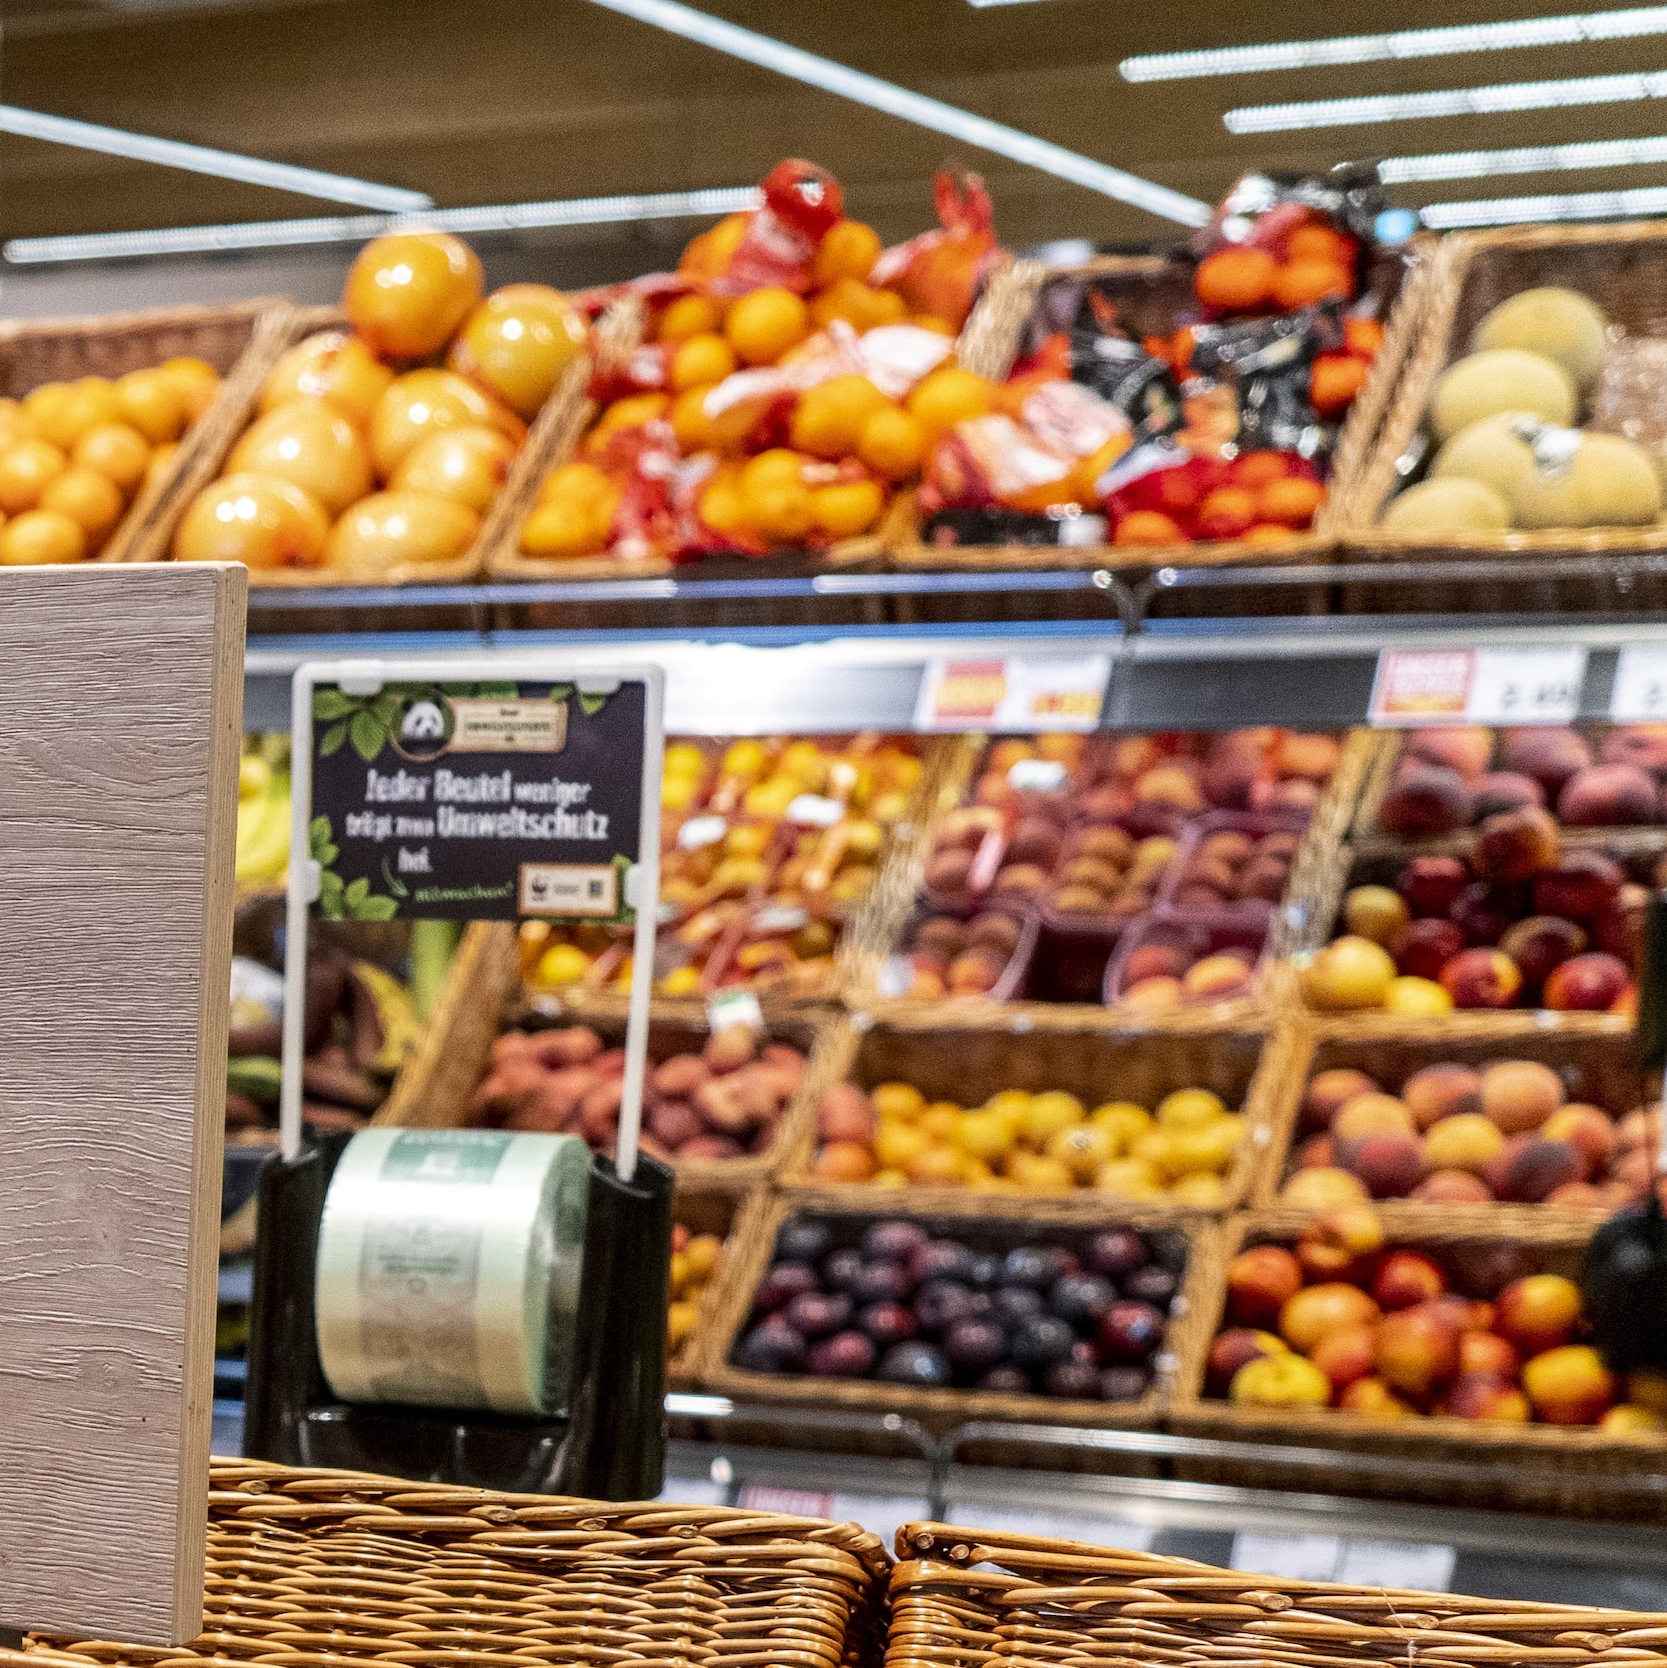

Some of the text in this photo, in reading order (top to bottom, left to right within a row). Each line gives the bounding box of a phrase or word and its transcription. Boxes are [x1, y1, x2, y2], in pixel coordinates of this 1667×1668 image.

[365, 769, 592, 807] Jeder Beutel weniger
[436, 804, 610, 839] Umweltschutz
